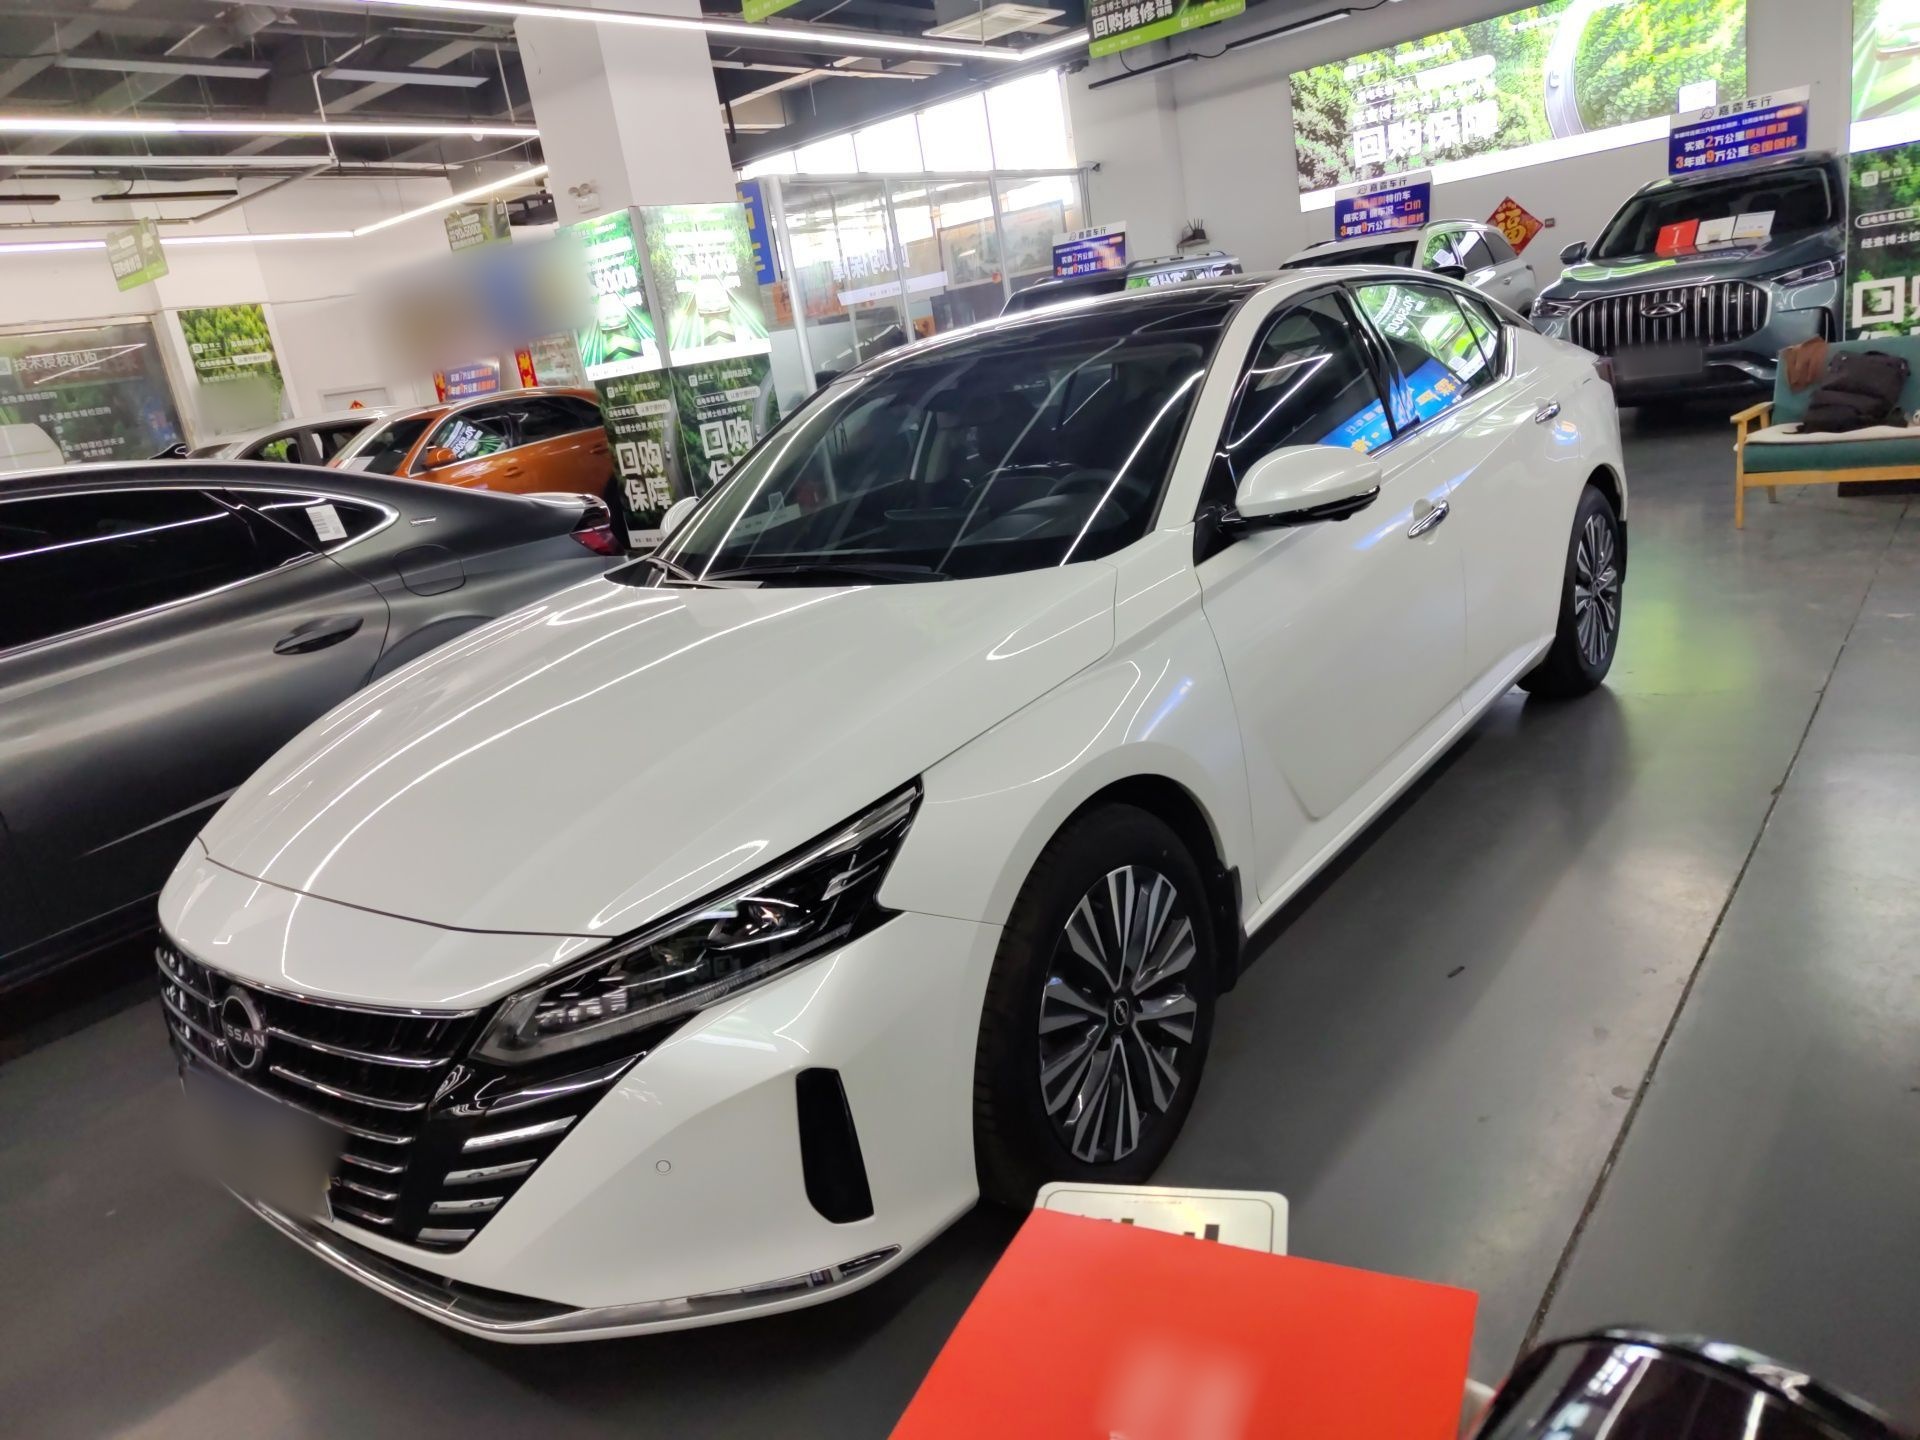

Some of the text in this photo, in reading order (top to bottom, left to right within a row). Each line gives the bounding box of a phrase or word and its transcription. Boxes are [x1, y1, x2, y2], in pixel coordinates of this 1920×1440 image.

[1092, 4, 1156, 38] 回购维修
[699, 416, 751, 460] 回购
[616, 439, 664, 477] 回购
[624, 477, 672, 512] 保障
